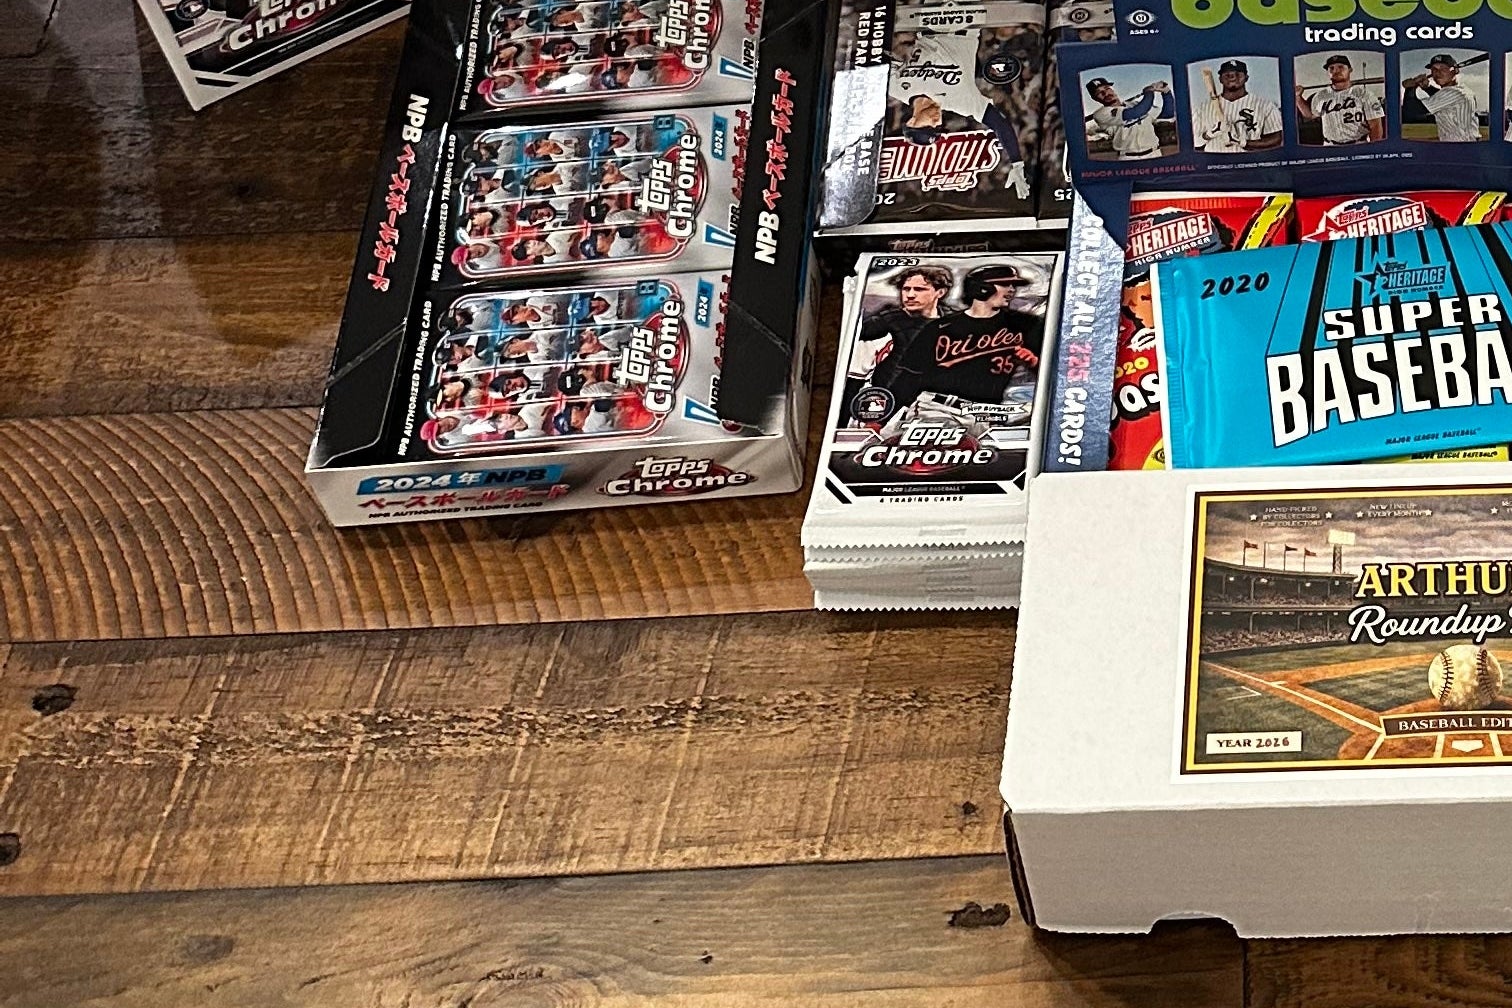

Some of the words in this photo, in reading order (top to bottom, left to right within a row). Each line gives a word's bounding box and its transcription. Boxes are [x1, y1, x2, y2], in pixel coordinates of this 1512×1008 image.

[1305, 24, 1397, 46] trading
[1406, 22, 1474, 42] cards
[761, 67, 799, 211] ベースボールカード
[754, 210, 781, 265] NPB
[1199, 270, 1271, 301] 2020
[1322, 293, 1503, 341] SUPER
[935, 328, 1023, 365] Orioles
[861, 445, 993, 467] Chrome
[359, 483, 569, 511] ベースボールカード
[604, 470, 749, 497] Chrome
[393, 505, 461, 517] AUTHORIZED
[463, 503, 512, 513] TRADING
[513, 501, 543, 509] CARD
[1348, 603, 1508, 645] Roundup
[1398, 717, 1477, 731] BASEBALL
[1215, 737, 1253, 750] YEAR
[1255, 736, 1290, 749] 2026
